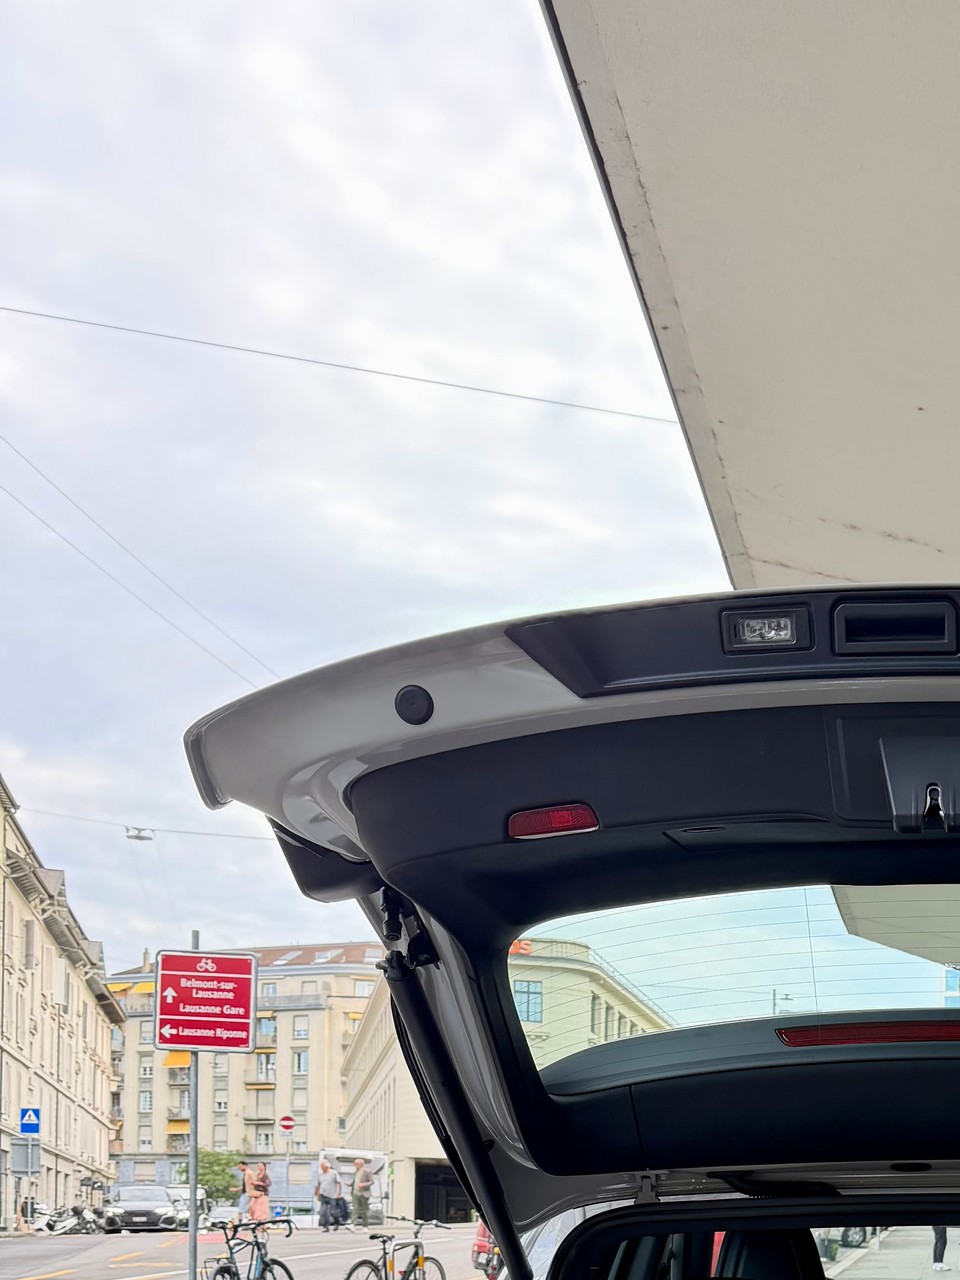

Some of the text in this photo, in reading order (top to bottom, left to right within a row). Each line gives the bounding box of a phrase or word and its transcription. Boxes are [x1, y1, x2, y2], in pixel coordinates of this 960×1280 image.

[180, 978, 238, 990] Belmont-sur-
[192, 989, 235, 999] Lausanne
[179, 1003, 245, 1015] Lausanne Gare
[178, 1026, 248, 1040] Lausanne Riponne
